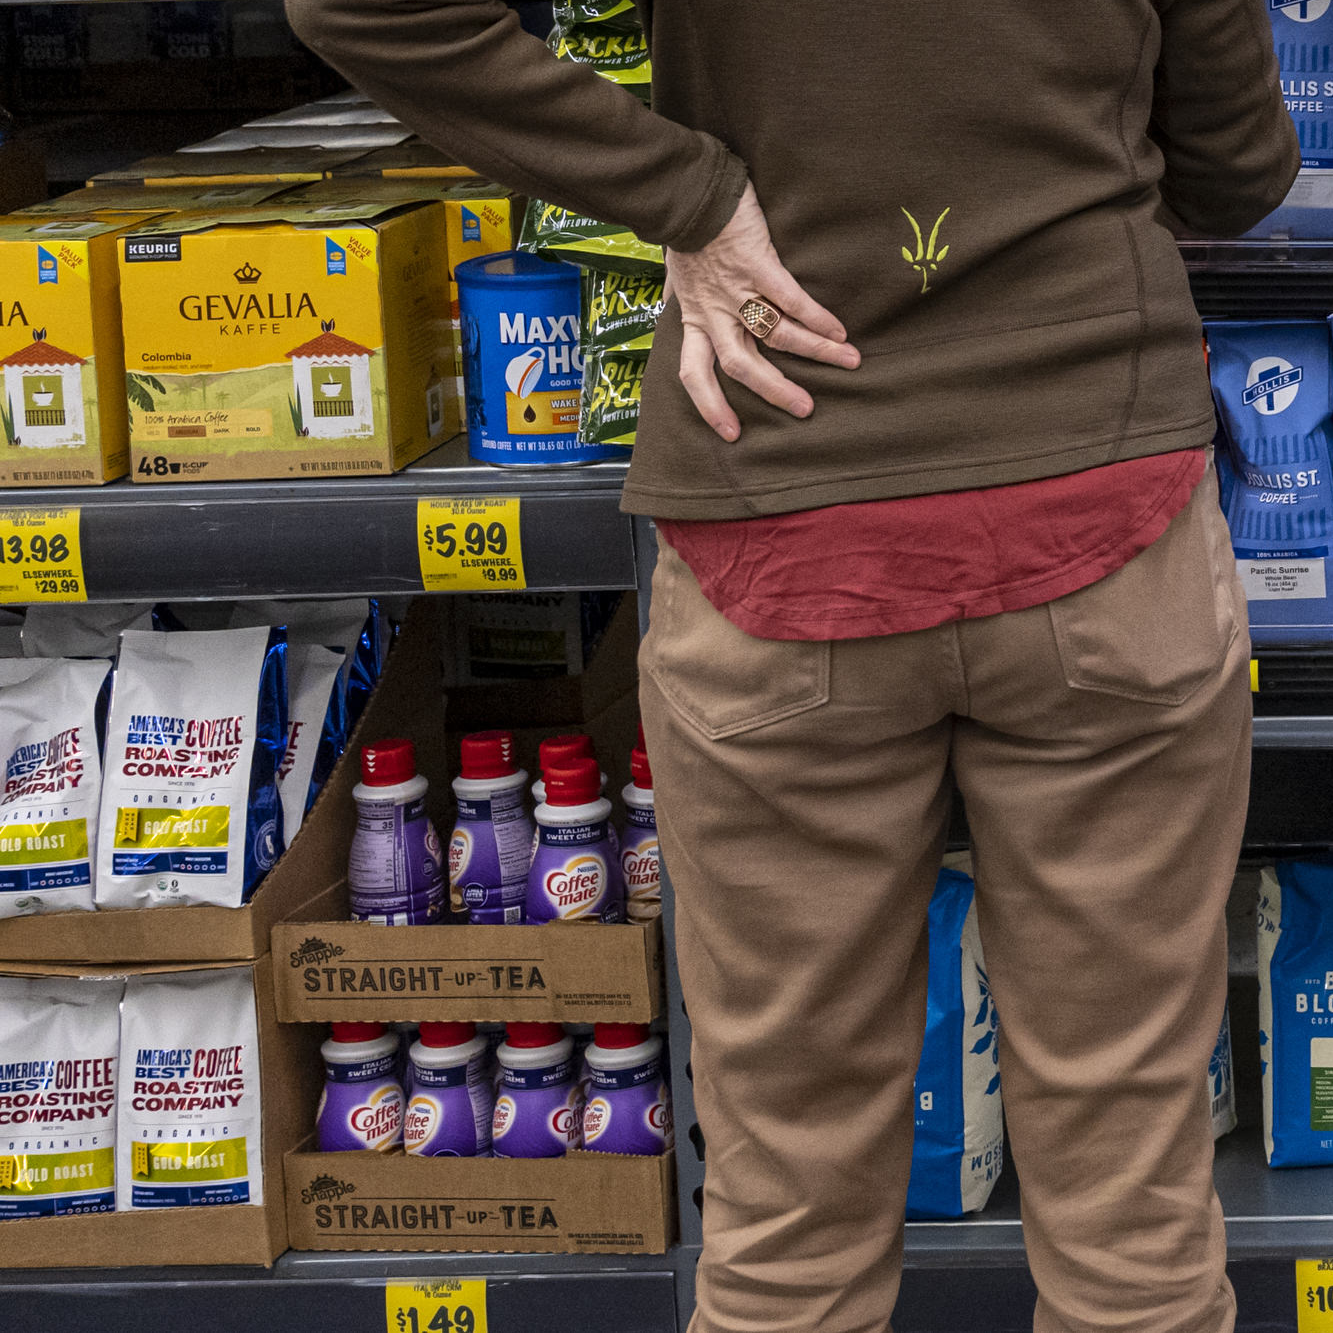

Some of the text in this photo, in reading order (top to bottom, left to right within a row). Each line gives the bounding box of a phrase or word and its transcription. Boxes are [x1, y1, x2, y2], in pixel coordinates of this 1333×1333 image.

[129, 244, 177, 254] KEURIG
[349, 236, 372, 257] VALUE
[179, 292, 318, 321] GEVALIA
[220, 323, 281, 335] KAFFE
[142, 352, 191, 362] Colombia
[145, 412, 228, 424] 100% Arabica Coffee
[138, 456, 168, 476] 48
[424, 522, 507, 558] $5.99
[482, 568, 517, 581] $9.99
[35, 579, 79, 593] $29.99
[128, 715, 185, 734] AMERICA'S
[185, 716, 243, 748] COFFEE
[127, 733, 182, 746] BEST
[125, 747, 239, 763] ROASTING
[122, 762, 236, 779] COMPANY
[546, 870, 599, 896] Coffee
[290, 943, 345, 969] Snapple
